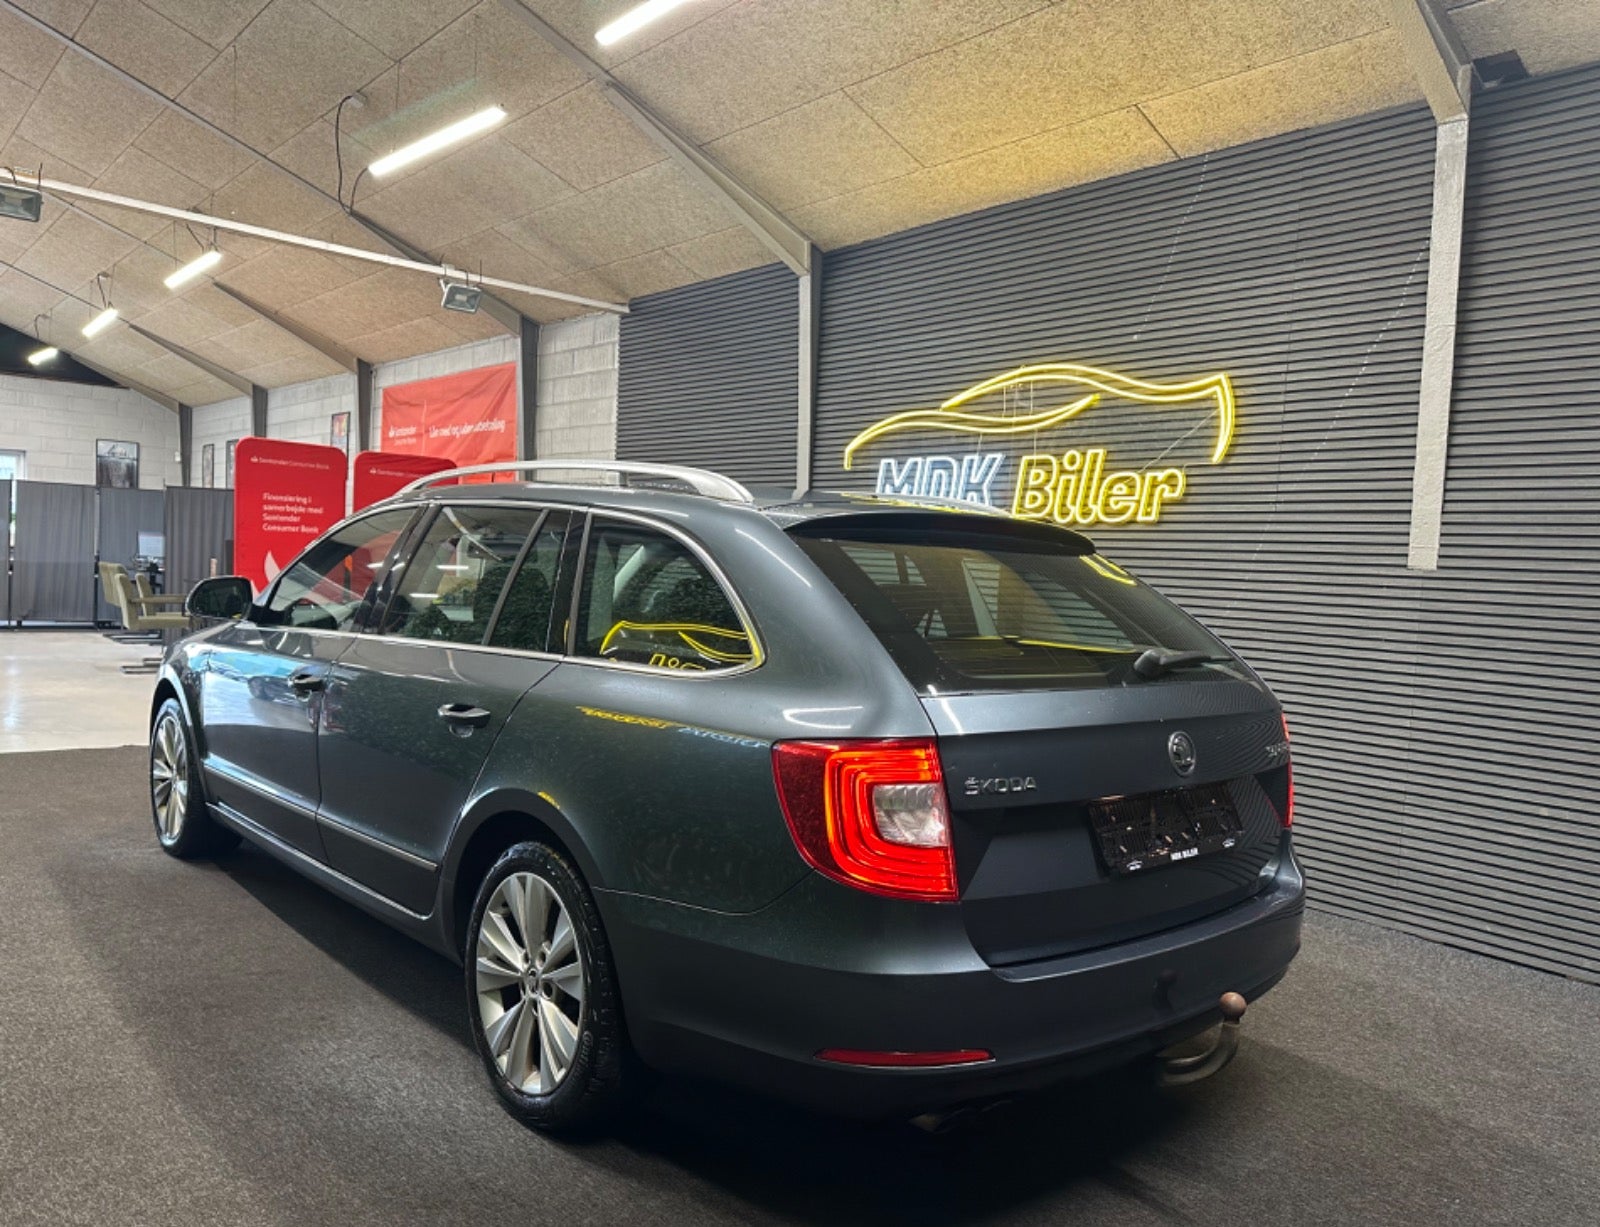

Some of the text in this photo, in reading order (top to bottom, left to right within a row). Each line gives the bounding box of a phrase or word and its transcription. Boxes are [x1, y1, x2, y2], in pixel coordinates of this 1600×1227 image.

[875, 447, 1186, 525] MDK Biler
[262, 492, 307, 505] Finansiering
[263, 504, 324, 515] samarbejde med
[262, 512, 301, 522] Santander
[262, 523, 319, 534] Consumer Bank
